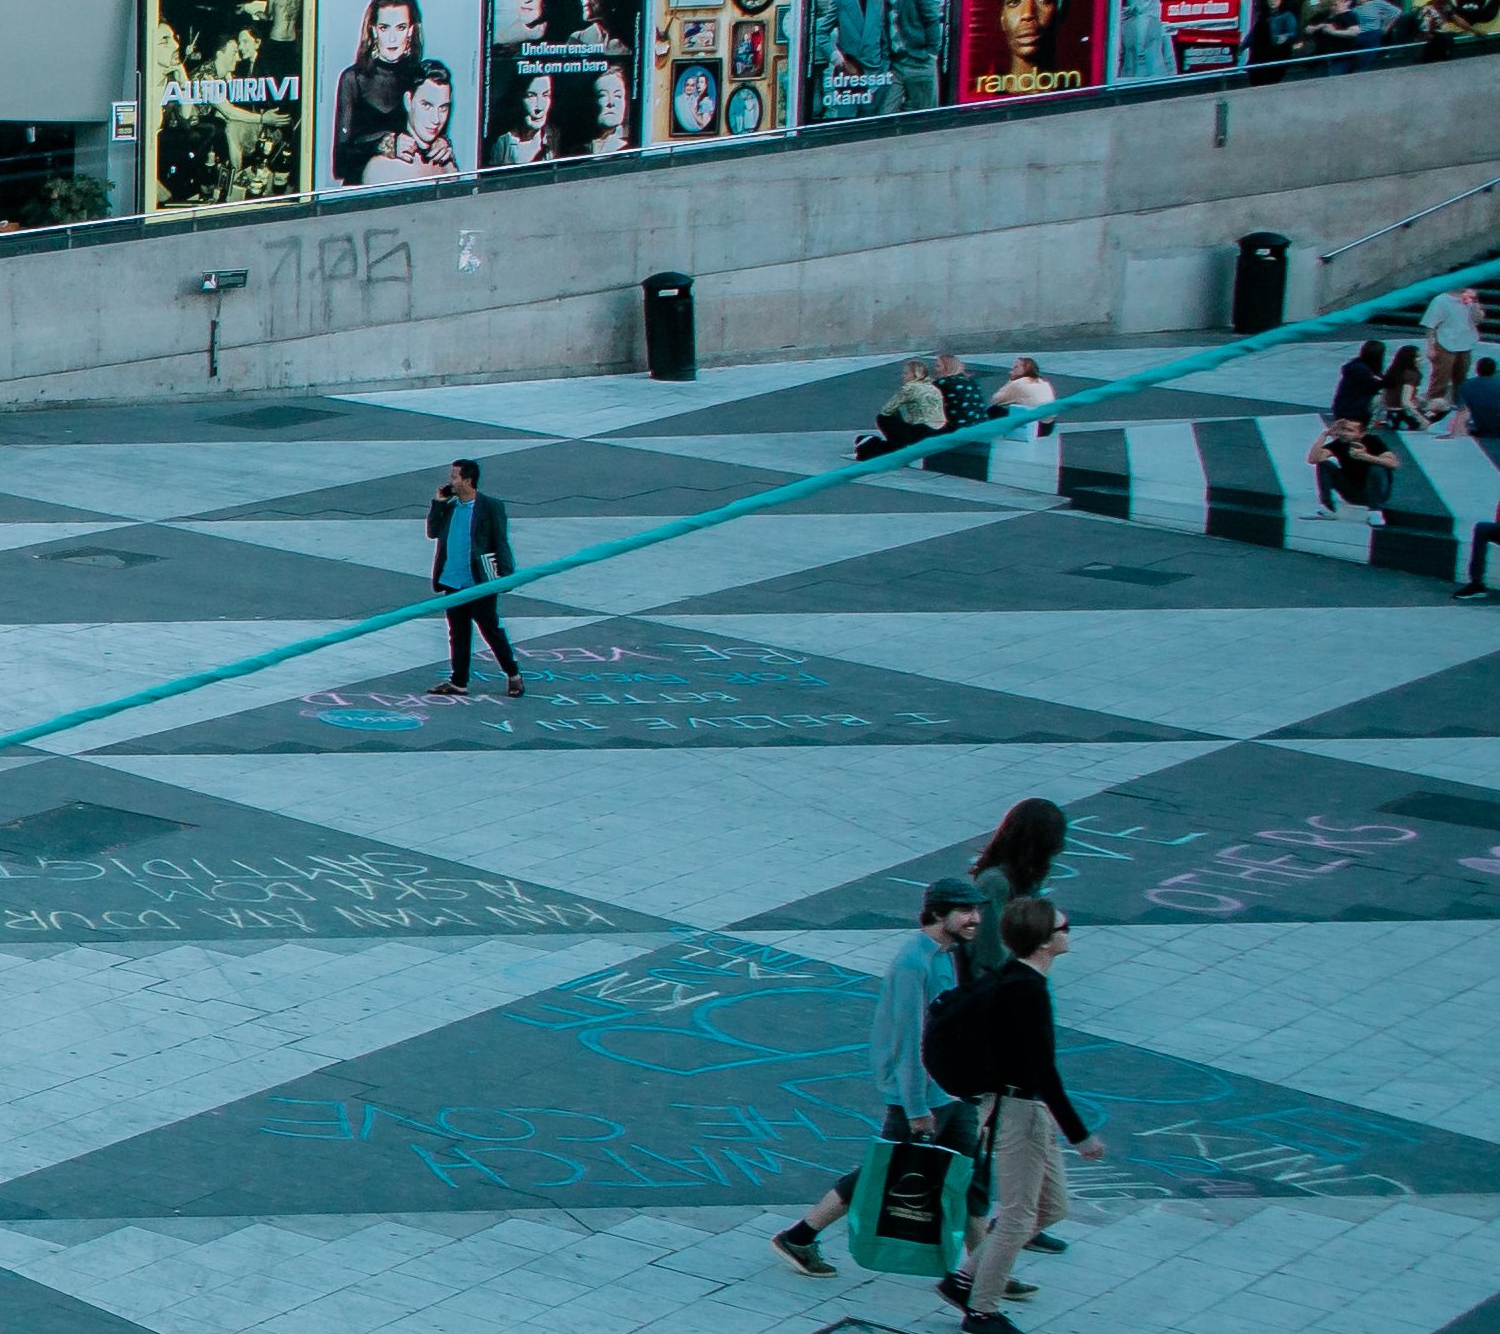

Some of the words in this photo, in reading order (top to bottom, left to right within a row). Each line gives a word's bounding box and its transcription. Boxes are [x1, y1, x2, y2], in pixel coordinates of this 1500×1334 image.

[568, 43, 604, 54] ensam
[544, 62, 562, 73] om
[563, 62, 581, 73] om
[582, 58, 608, 73] bara
[266, 75, 300, 100] VI
[822, 71, 894, 90] adressat
[976, 68, 1082, 93] random
[822, 88, 872, 106] okänd
[657, 643, 808, 665] BE
[522, 690, 741, 706] BETTER
[481, 720, 515, 733] A
[1143, 815, 1418, 912] OTHERS
[410, 1143, 849, 1187] WATCH
